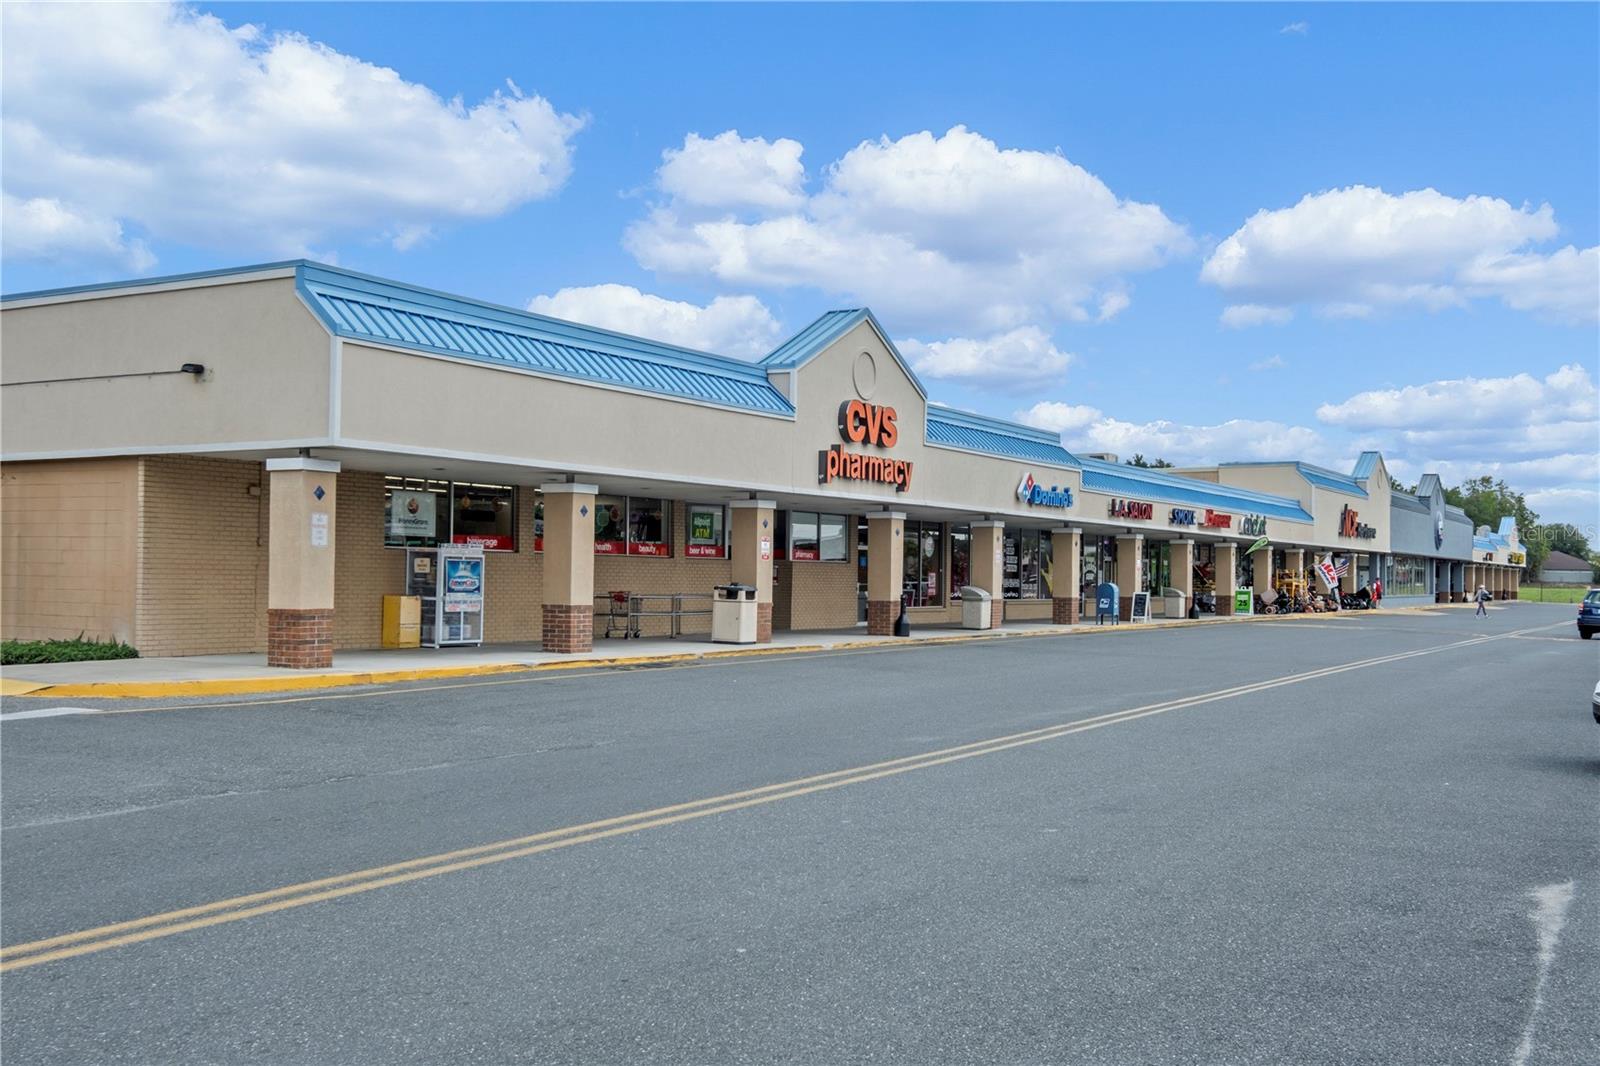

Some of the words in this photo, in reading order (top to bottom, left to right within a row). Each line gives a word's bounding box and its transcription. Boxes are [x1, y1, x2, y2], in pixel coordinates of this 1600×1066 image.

[841, 399, 897, 448] CVS
[819, 443, 913, 492] pharmacy
[1128, 500, 1153, 520] SALON
[695, 527, 710, 538] ATM
[639, 544, 656, 554] beauty
